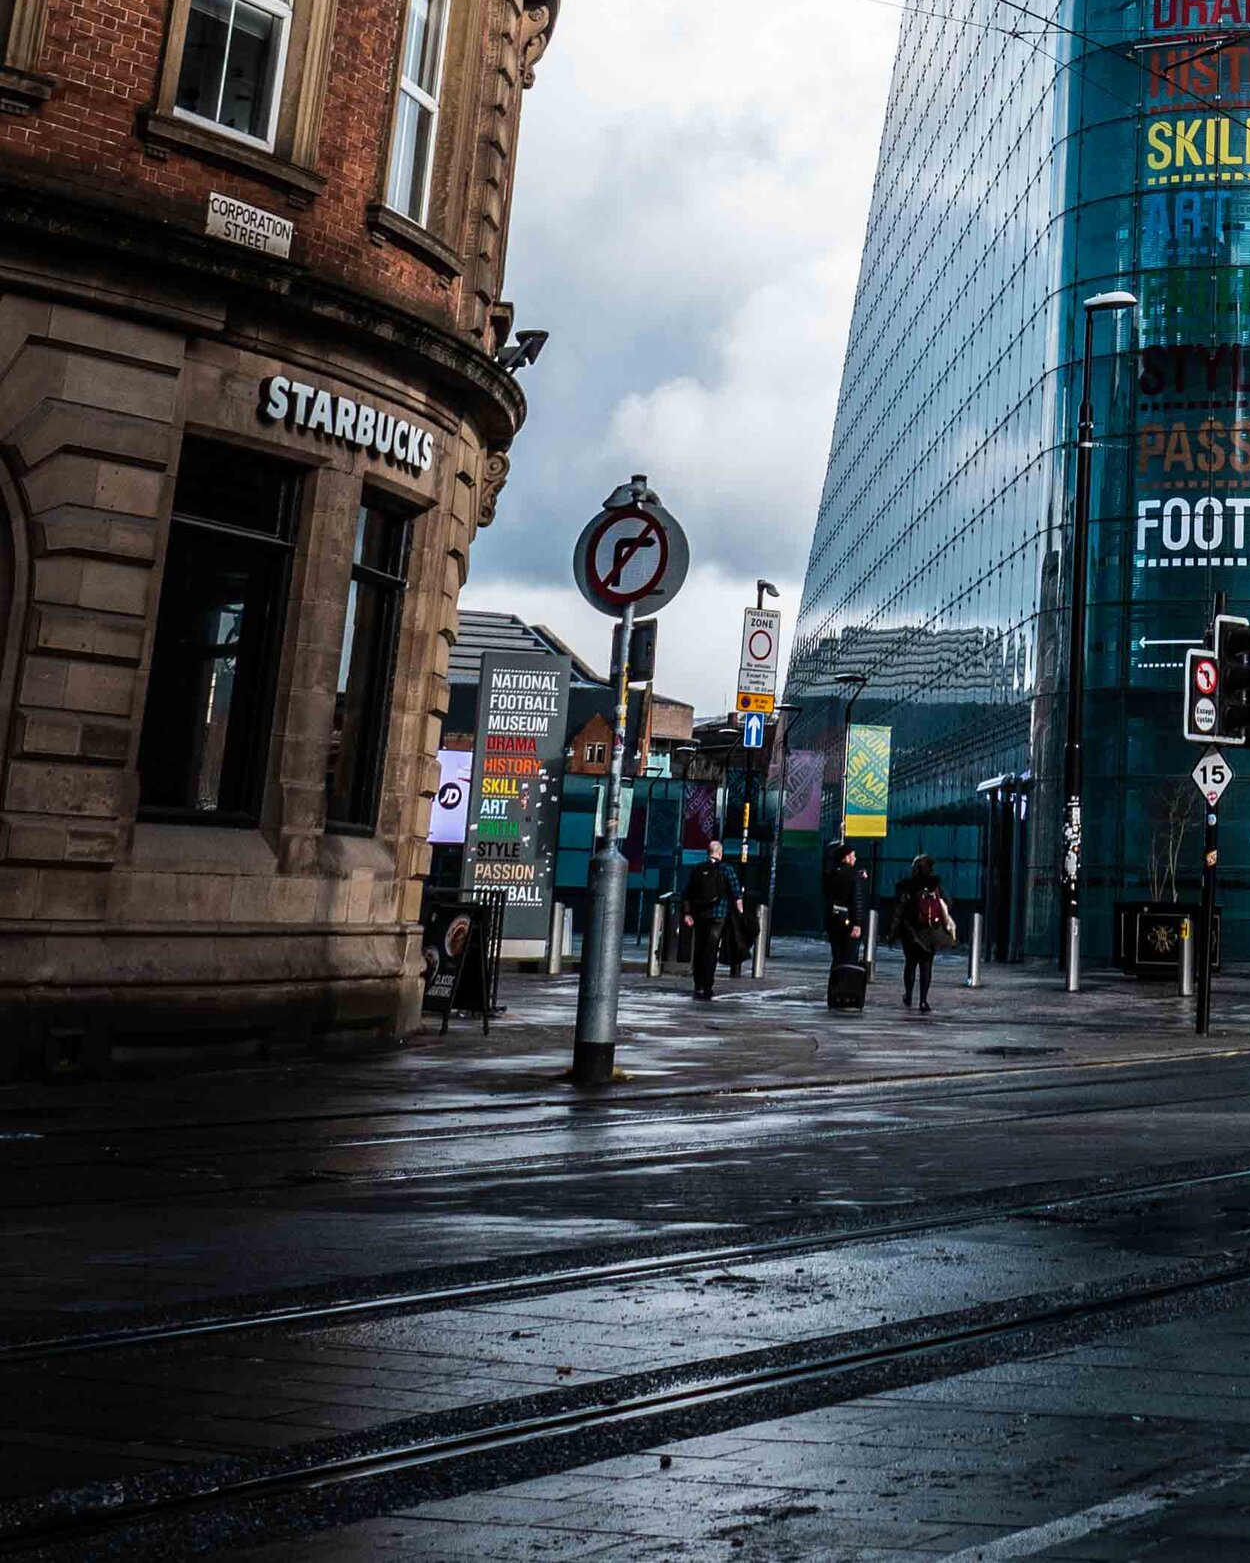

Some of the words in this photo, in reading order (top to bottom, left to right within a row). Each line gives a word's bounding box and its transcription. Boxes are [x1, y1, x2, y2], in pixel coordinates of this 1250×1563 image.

[211, 197, 292, 241] CORPORATION
[1144, 189, 1232, 239] ART
[224, 221, 270, 251] STREET
[266, 376, 434, 472] STARBUCKS
[750, 618, 774, 629] ZONE
[491, 673, 559, 691] NATIONAL
[489, 694, 558, 712] FOOTBALL
[488, 715, 549, 732] MUSEUM
[485, 735, 537, 752] DRAMA
[483, 757, 544, 775] HISTORY
[1199, 765, 1225, 785] 15
[481, 777, 520, 794] SKILL
[440, 788, 460, 804] JD
[479, 799, 509, 815] ART
[478, 820, 520, 837] FAITH
[477, 841, 520, 858] STYLE
[474, 863, 535, 880] PASSION
